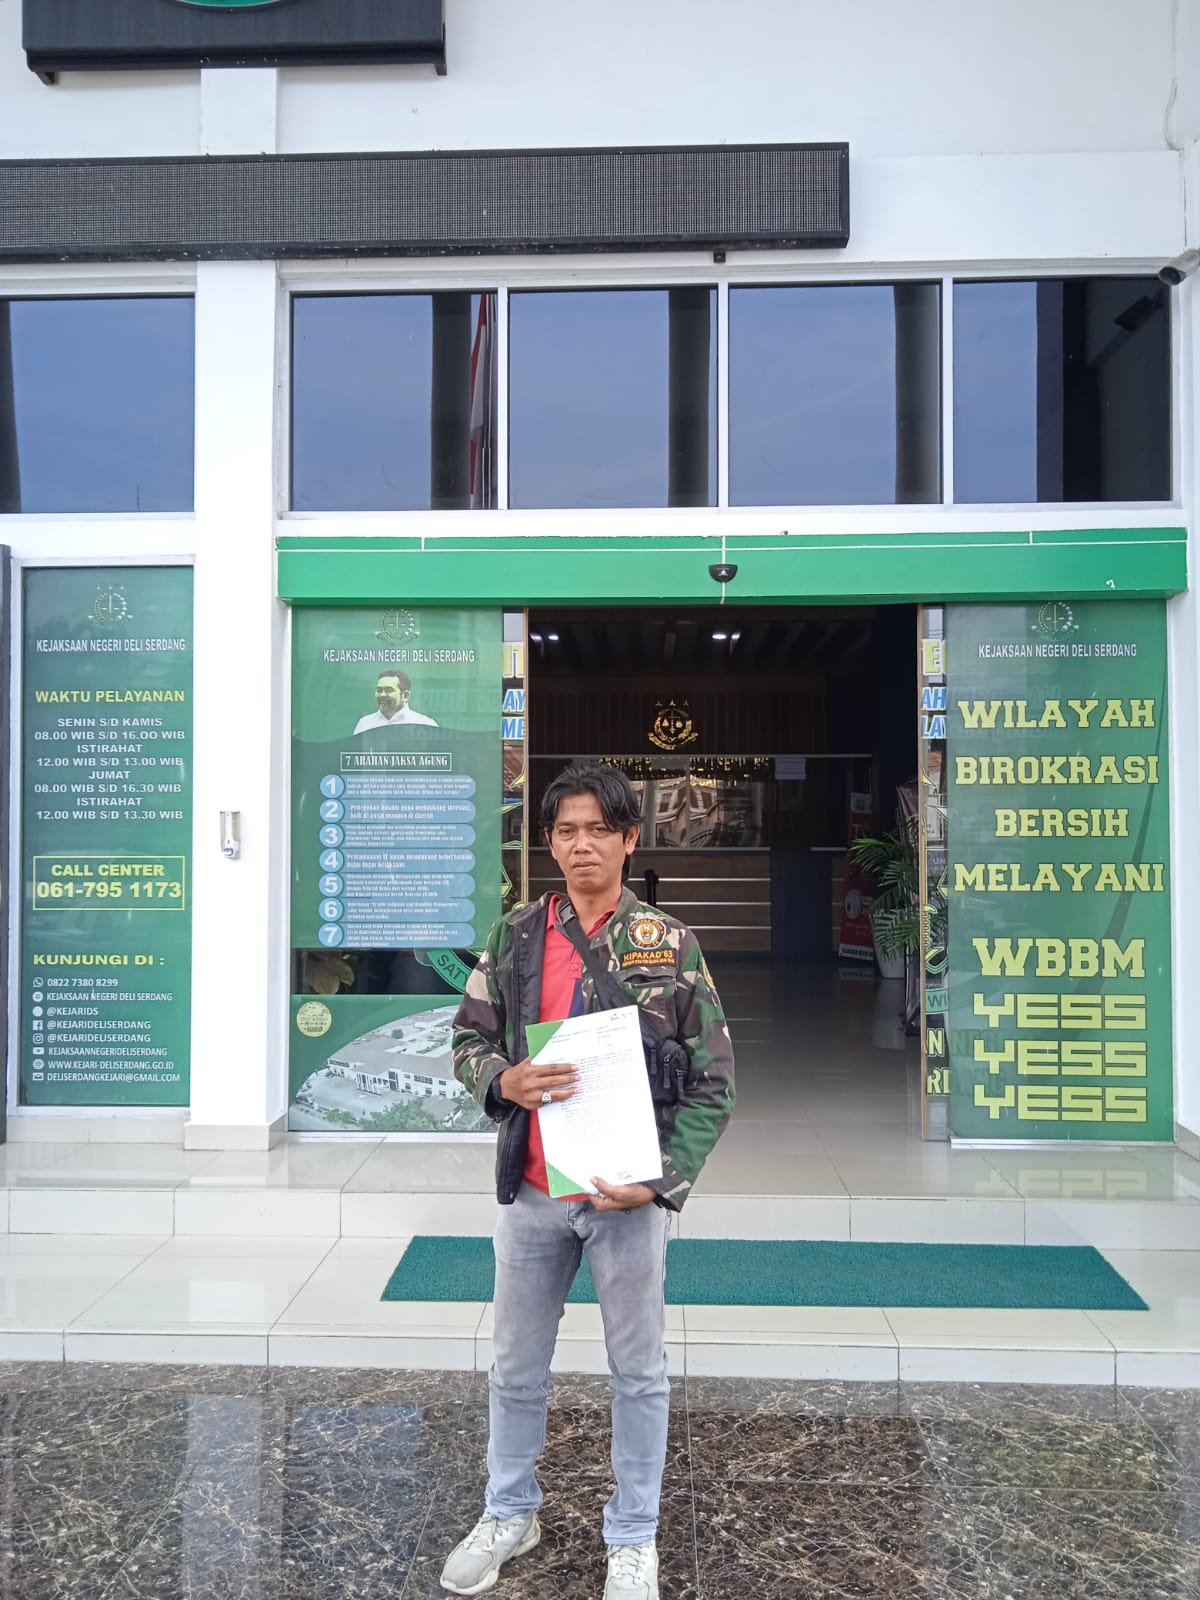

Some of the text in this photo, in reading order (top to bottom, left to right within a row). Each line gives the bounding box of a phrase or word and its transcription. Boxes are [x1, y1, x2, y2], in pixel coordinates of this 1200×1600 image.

[36, 639, 186, 652] KEJAKSAAN NEGERI DELI SERDANG
[978, 644, 1137, 658] KEJAKSAAN NEGERI DELI SERDANG
[323, 650, 475, 663] KEJAKSAAN NEGERI DELI SERDANG
[36, 690, 185, 702] WAKTU PELAYANAN
[957, 699, 1156, 728] WILAYAH
[57, 718, 163, 728] SENIN S/D KAMIS
[34, 730, 68, 741] 08.00
[71, 730, 95, 741] WIB
[98, 730, 118, 741] S/D
[162, 730, 186, 741] WIB
[76, 744, 144, 754] ISTIRAHAT
[36, 757, 184, 767] 12.00 WIB S/D 13.00 WIB
[345, 754, 448, 766] 7 ARAHAN JAKSA AGUNG
[88, 770, 132, 780] JUMAT
[955, 756, 1159, 784] BIROKRASI
[34, 783, 182, 794] 08.00 WIB S/D 16.30 WIB
[325, 778, 338, 795] 1
[76, 797, 143, 806] ISTIRAHAT
[36, 810, 184, 820] 12.00 WIB S/D 13.30 WIB
[324, 802, 340, 818] 2
[994, 808, 1129, 838] BERSIH
[324, 828, 339, 844] 3
[324, 852, 339, 868] 4
[52, 864, 164, 876] CALL CENTER
[954, 863, 1165, 892] MELAYANI
[36, 882, 182, 898] 061-795 1173
[324, 876, 338, 893] 5
[324, 901, 338, 918] 6
[324, 926, 338, 944] 7
[33, 954, 128, 965] KUNJUNGI
[134, 954, 154, 965] DI
[972, 938, 1146, 978] WBBM
[47, 978, 118, 987] 0822 7380 8299
[46, 992, 172, 1001] KEJAKSAAN NEGERI DELI SERDANG
[46, 1007, 98, 1016] @KEJARIDS
[973, 992, 1147, 1030] YESS
[46, 1020, 151, 1030] @KEJARIDELISERDANG
[47, 1034, 151, 1043] @KEJARIDELISERDANG
[973, 1040, 1147, 1076] YESS
[973, 1084, 1147, 1122] YESS
